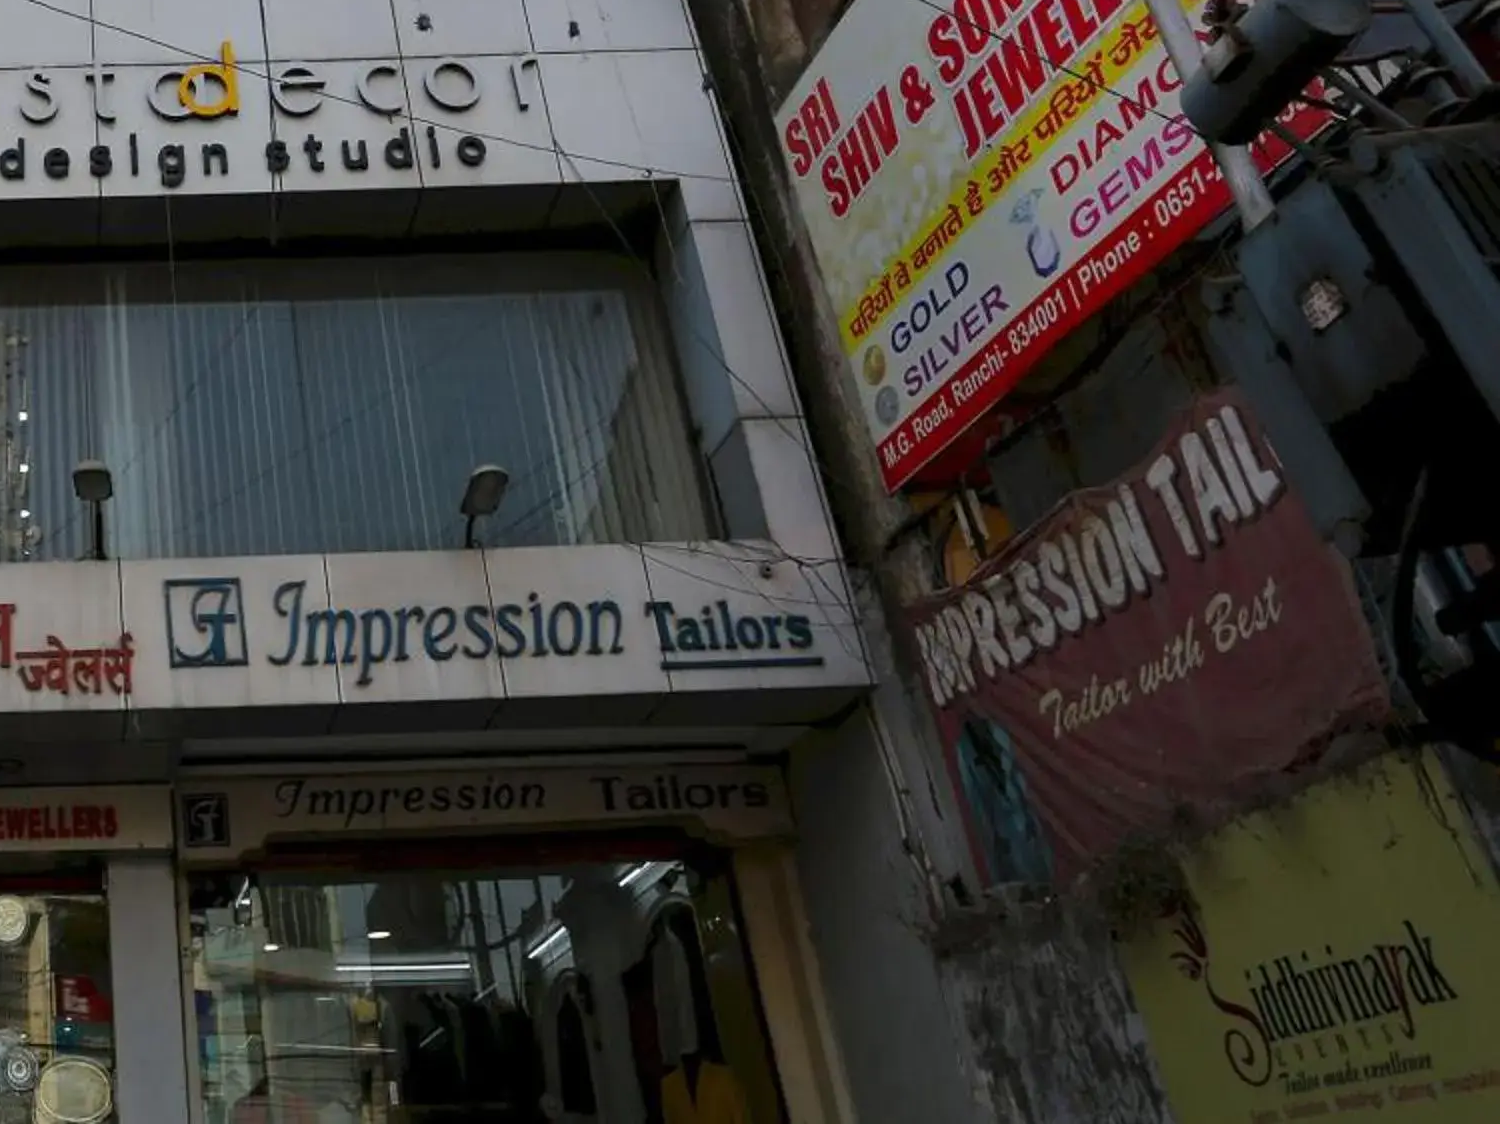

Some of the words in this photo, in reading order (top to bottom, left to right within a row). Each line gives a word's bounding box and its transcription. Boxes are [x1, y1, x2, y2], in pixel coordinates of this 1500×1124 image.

[266, 126, 488, 175] studio
[785, 76, 840, 177] SRI
[821, 84, 900, 217] SHIV
[900, 64, 936, 124] &
[1069, 114, 1195, 239] GEMS
[883, 429, 914, 468] M.G.
[912, 394, 955, 441] Road,
[1008, 291, 1068, 358] 834001
[1081, 230, 1141, 296] Phone
[890, 260, 970, 355] GOLD
[905, 284, 1011, 397] SILVER
[266, 579, 624, 687] Impression
[644, 600, 814, 654] Tailors
[1039, 673, 1132, 740] Tailor
[1137, 617, 1205, 697] with
[1205, 576, 1283, 654] Best
[274, 778, 546, 829] Impression
[589, 777, 769, 812] Tailors
[1224, 920, 1458, 1087] Siddhivinayak
